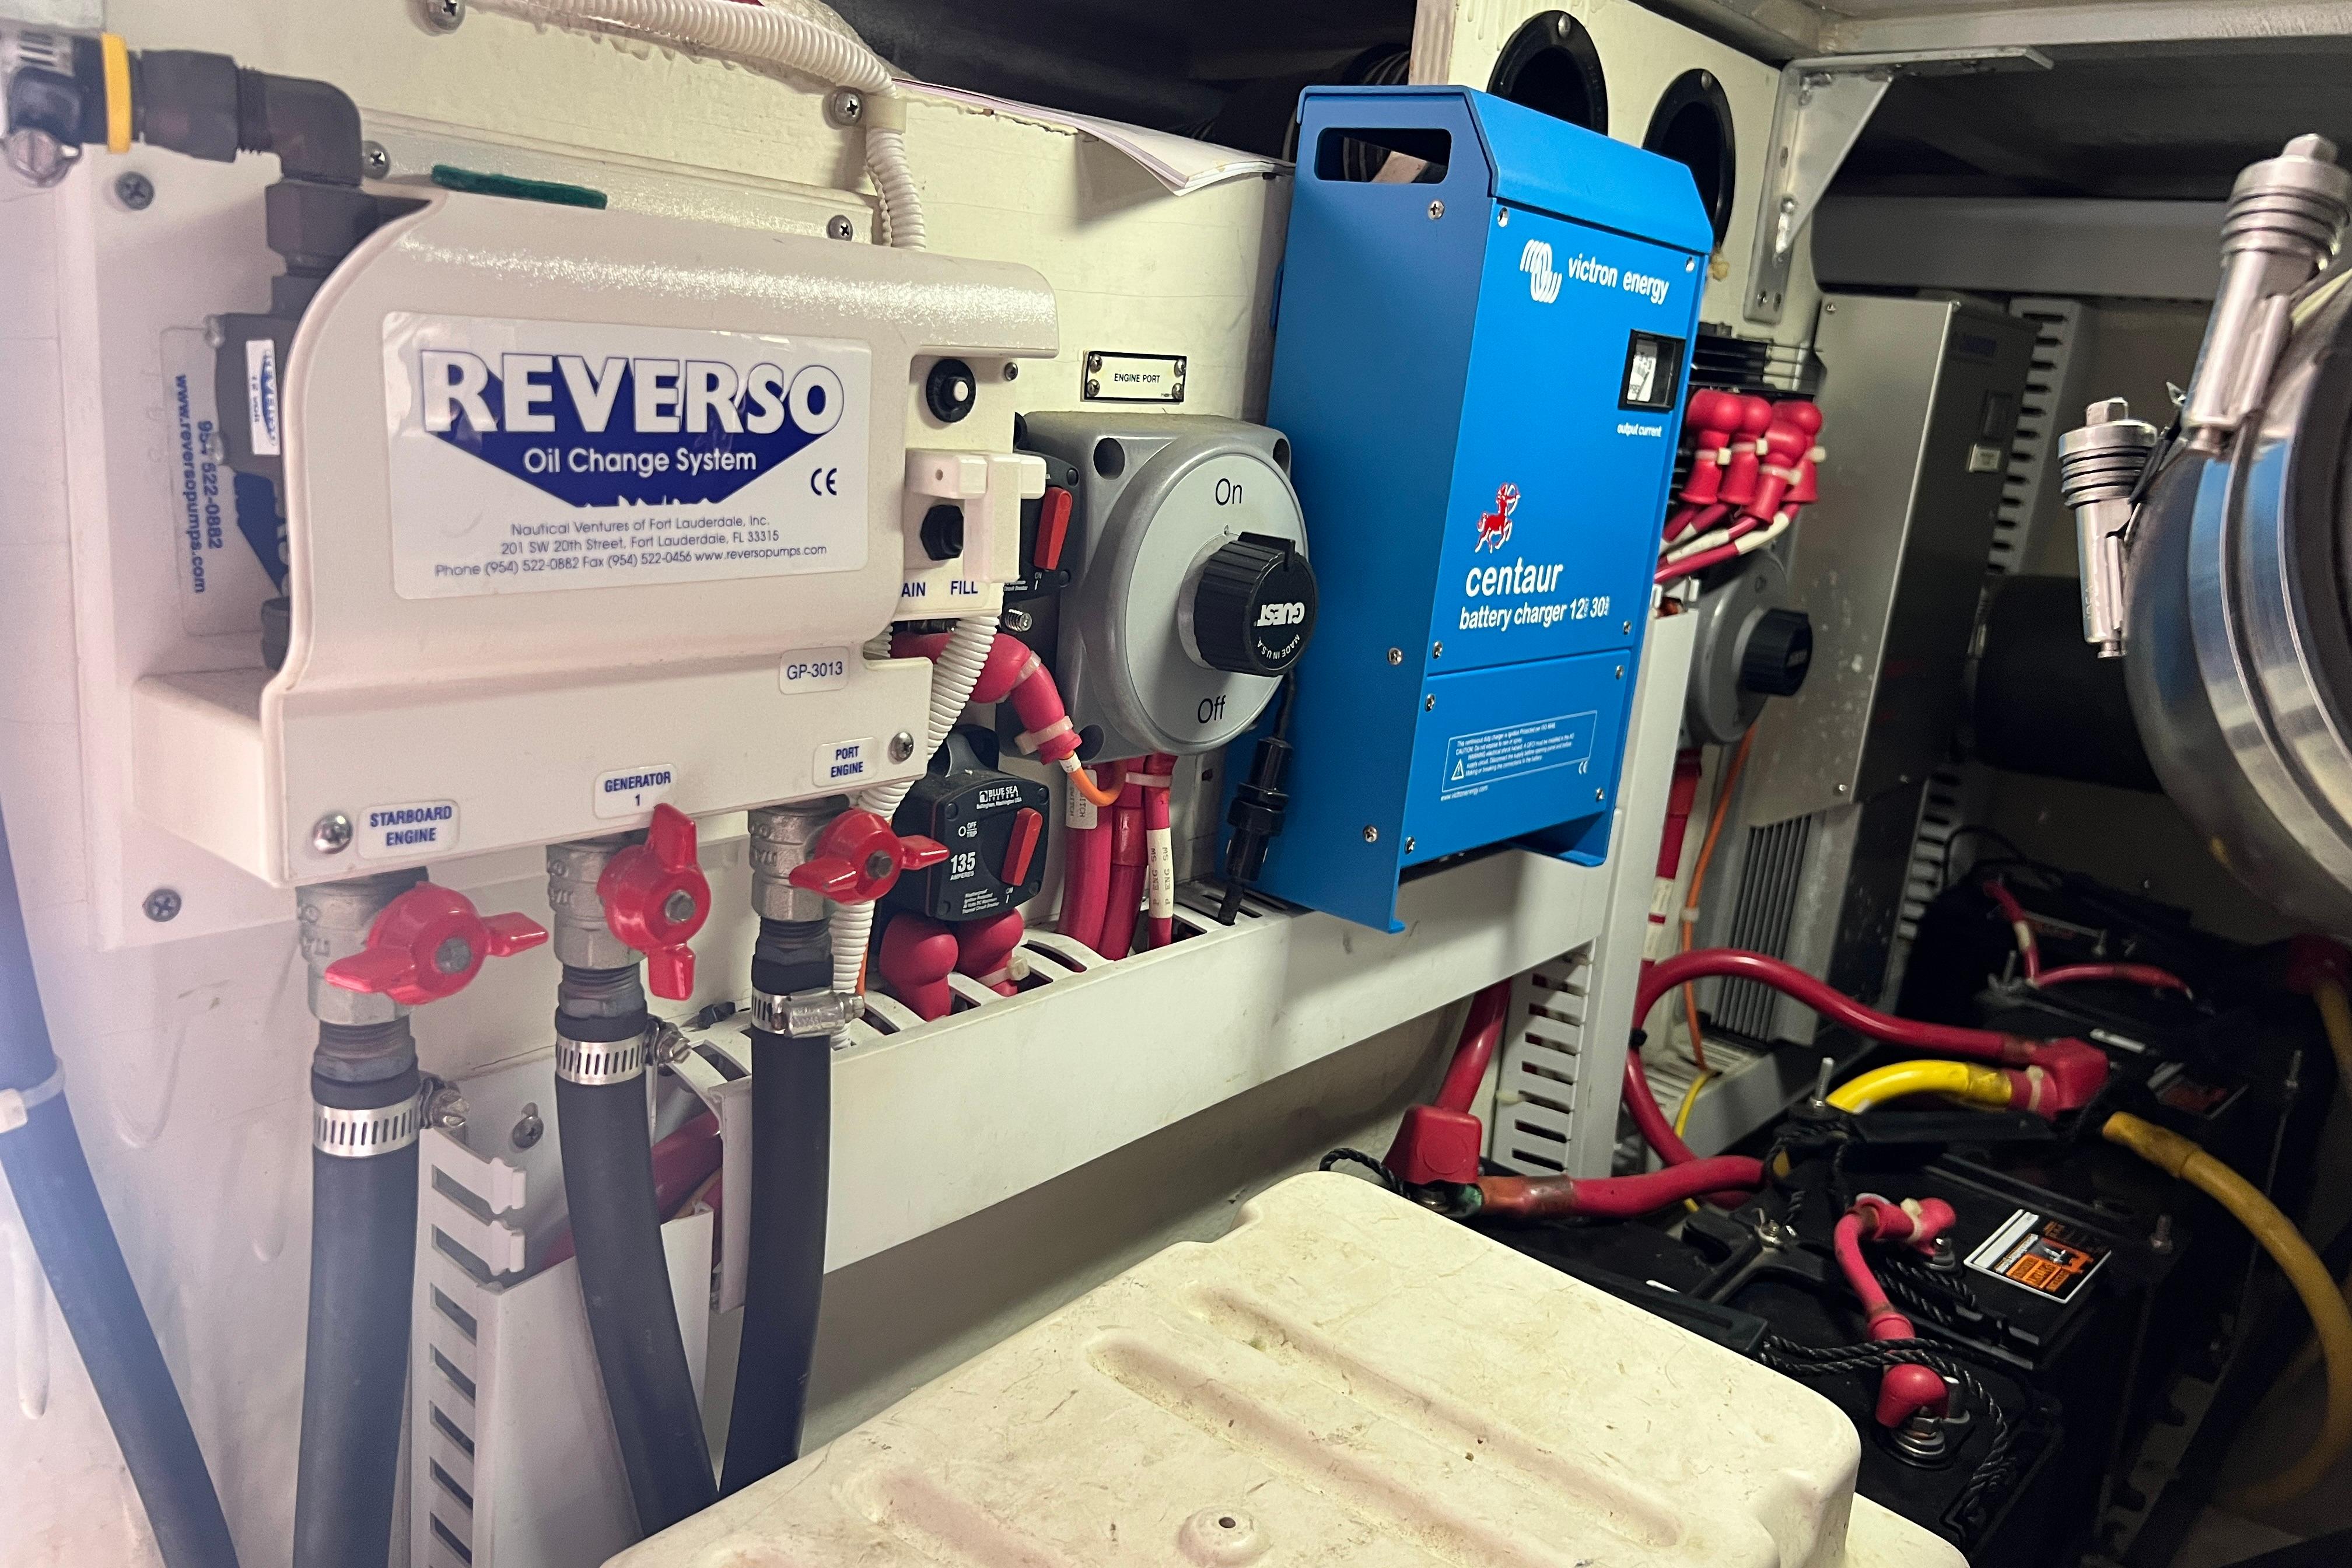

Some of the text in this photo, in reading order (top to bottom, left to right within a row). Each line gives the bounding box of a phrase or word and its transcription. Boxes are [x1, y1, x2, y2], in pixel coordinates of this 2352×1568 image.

[1569, 253, 1670, 305] victron energy
[1114, 372, 1160, 384] ENGINE PORT
[420, 350, 845, 435] REVERSO
[1617, 422, 1662, 438] output current
[523, 448, 757, 477] Oil Change System
[1214, 478, 1243, 506] On
[512, 516, 770, 537] Nautical Ventures of Fort Lauderdale, Inc.
[501, 530, 779, 556] 201 SW 20th Street, Fort Lauderdale, FL 33315
[435, 544, 827, 578] Phone (954) 522-0882 Fax (954) 522-0456 www.reversopumps.com
[1466, 557, 1564, 597] centaur
[901, 580, 978, 597] AIN FILL
[1256, 602, 1306, 627] GUEST
[1459, 603, 1512, 632] battery
[1514, 601, 1567, 628] charger
[1273, 651, 1280, 660] IN
[1281, 634, 1300, 657] MADE
[786, 661, 844, 681] GP-3013
[1198, 695, 1226, 724] Off
[835, 746, 859, 762] PORT
[830, 761, 863, 778] ENGINE
[604, 770, 671, 793] GENERATOR
[988, 785, 1019, 797] BLUE SEA
[635, 794, 640, 806] 1
[370, 805, 452, 827] STARBOARD
[386, 827, 437, 847] ENGINE
[951, 852, 976, 873] 135
[1162, 846, 1169, 862] SW
[1150, 847, 1160, 906] P ENG SW
